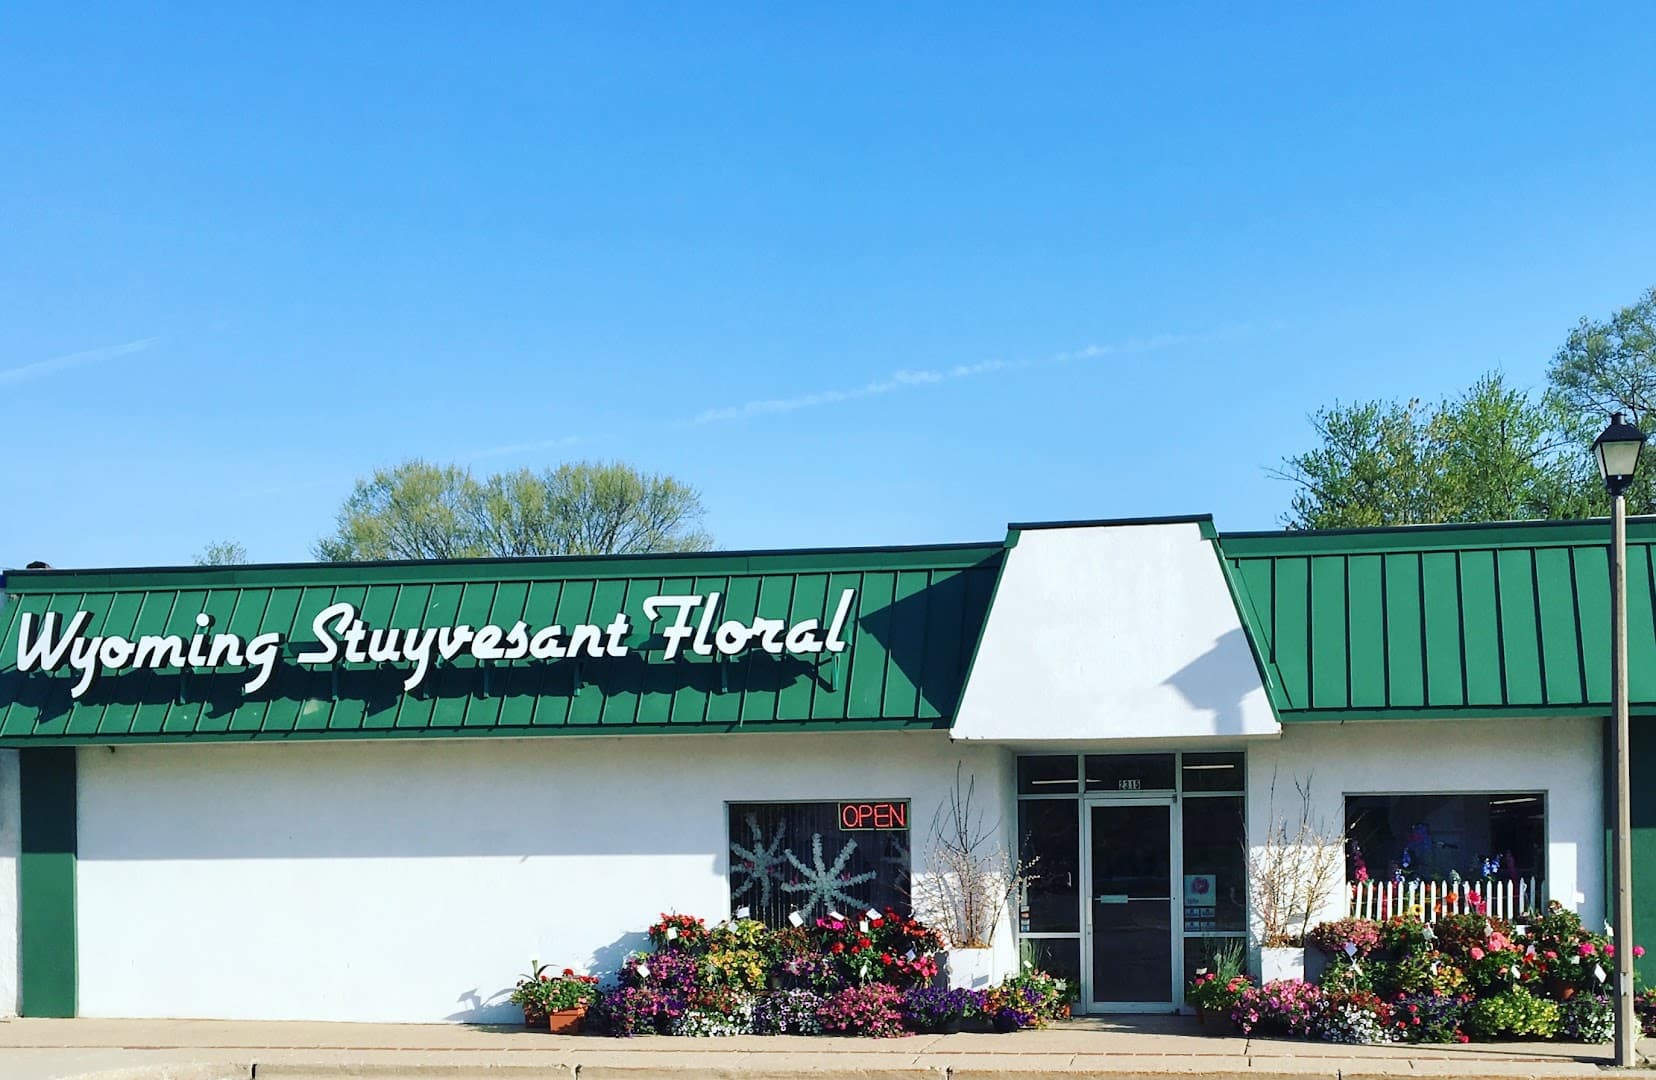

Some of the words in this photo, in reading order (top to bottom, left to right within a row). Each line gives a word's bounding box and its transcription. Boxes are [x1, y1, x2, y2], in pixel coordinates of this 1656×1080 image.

[17, 611, 279, 698] Wyoming
[297, 602, 629, 691] Stuyvesant
[642, 588, 854, 660] Floral
[842, 803, 905, 828] OPEN
